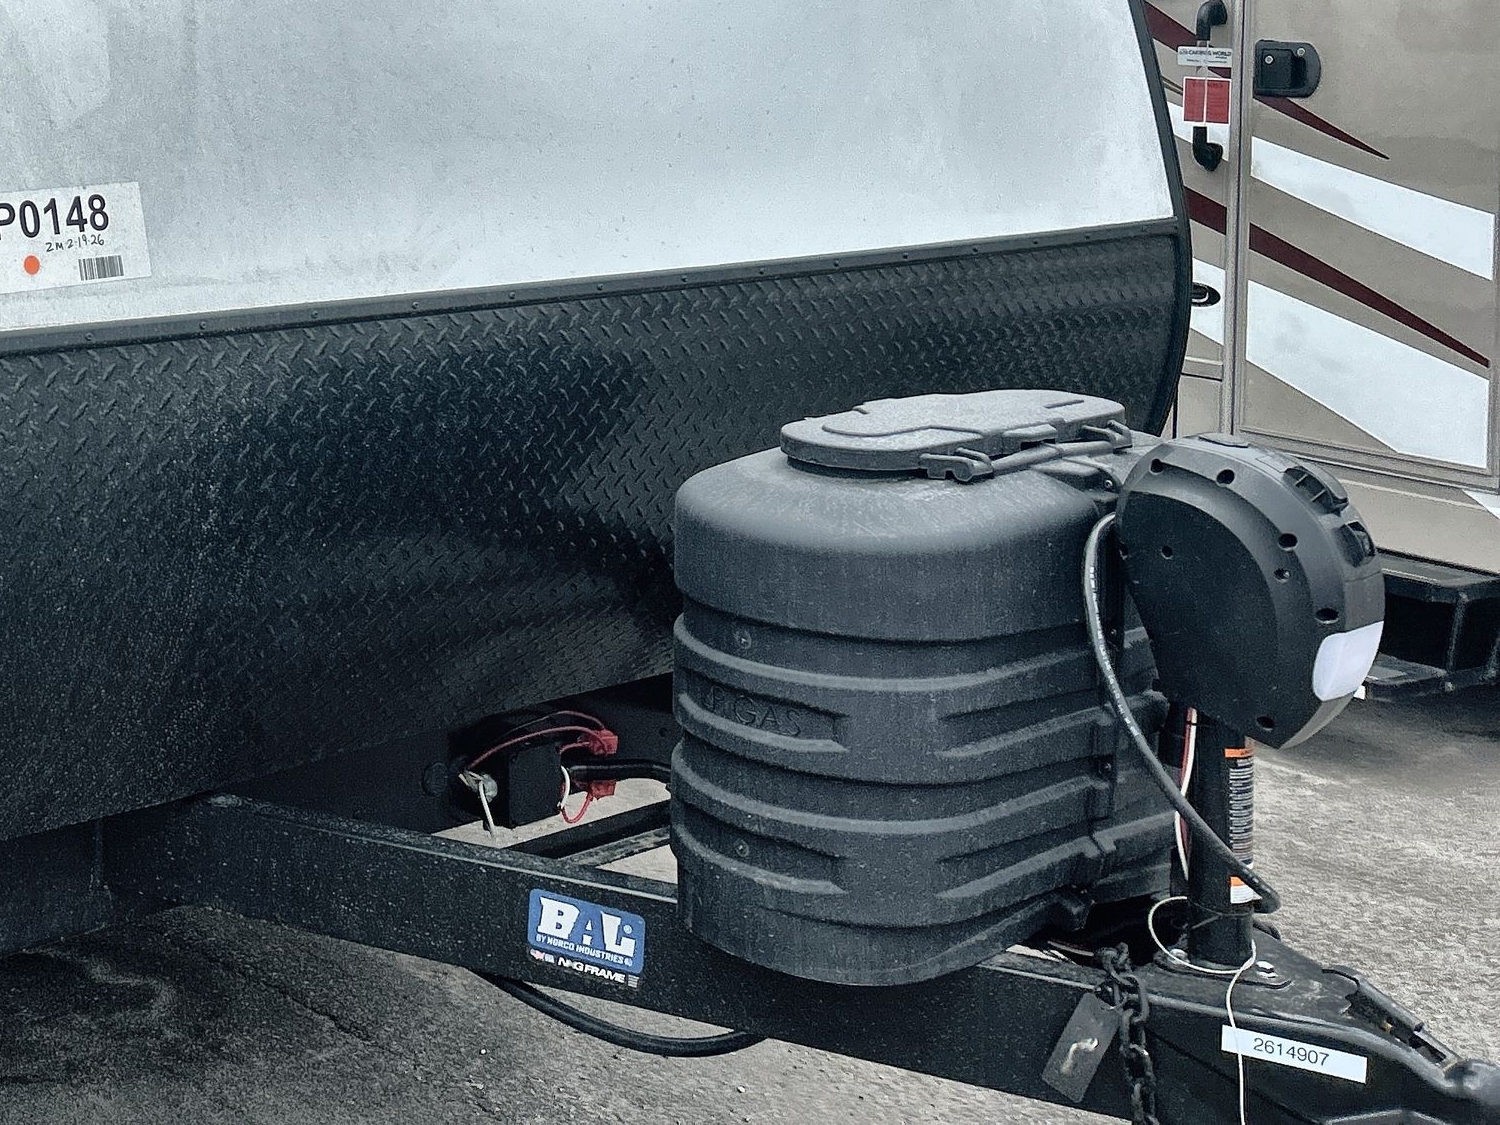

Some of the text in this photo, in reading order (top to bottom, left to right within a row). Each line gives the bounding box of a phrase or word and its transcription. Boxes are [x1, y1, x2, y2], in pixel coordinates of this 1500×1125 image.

[537, 896, 636, 957] BAL
[547, 938, 575, 951] NORCO
[576, 945, 625, 964] INDUSTRIES
[584, 964, 626, 983] FRAME
[1253, 1037, 1330, 1067] 2614907
